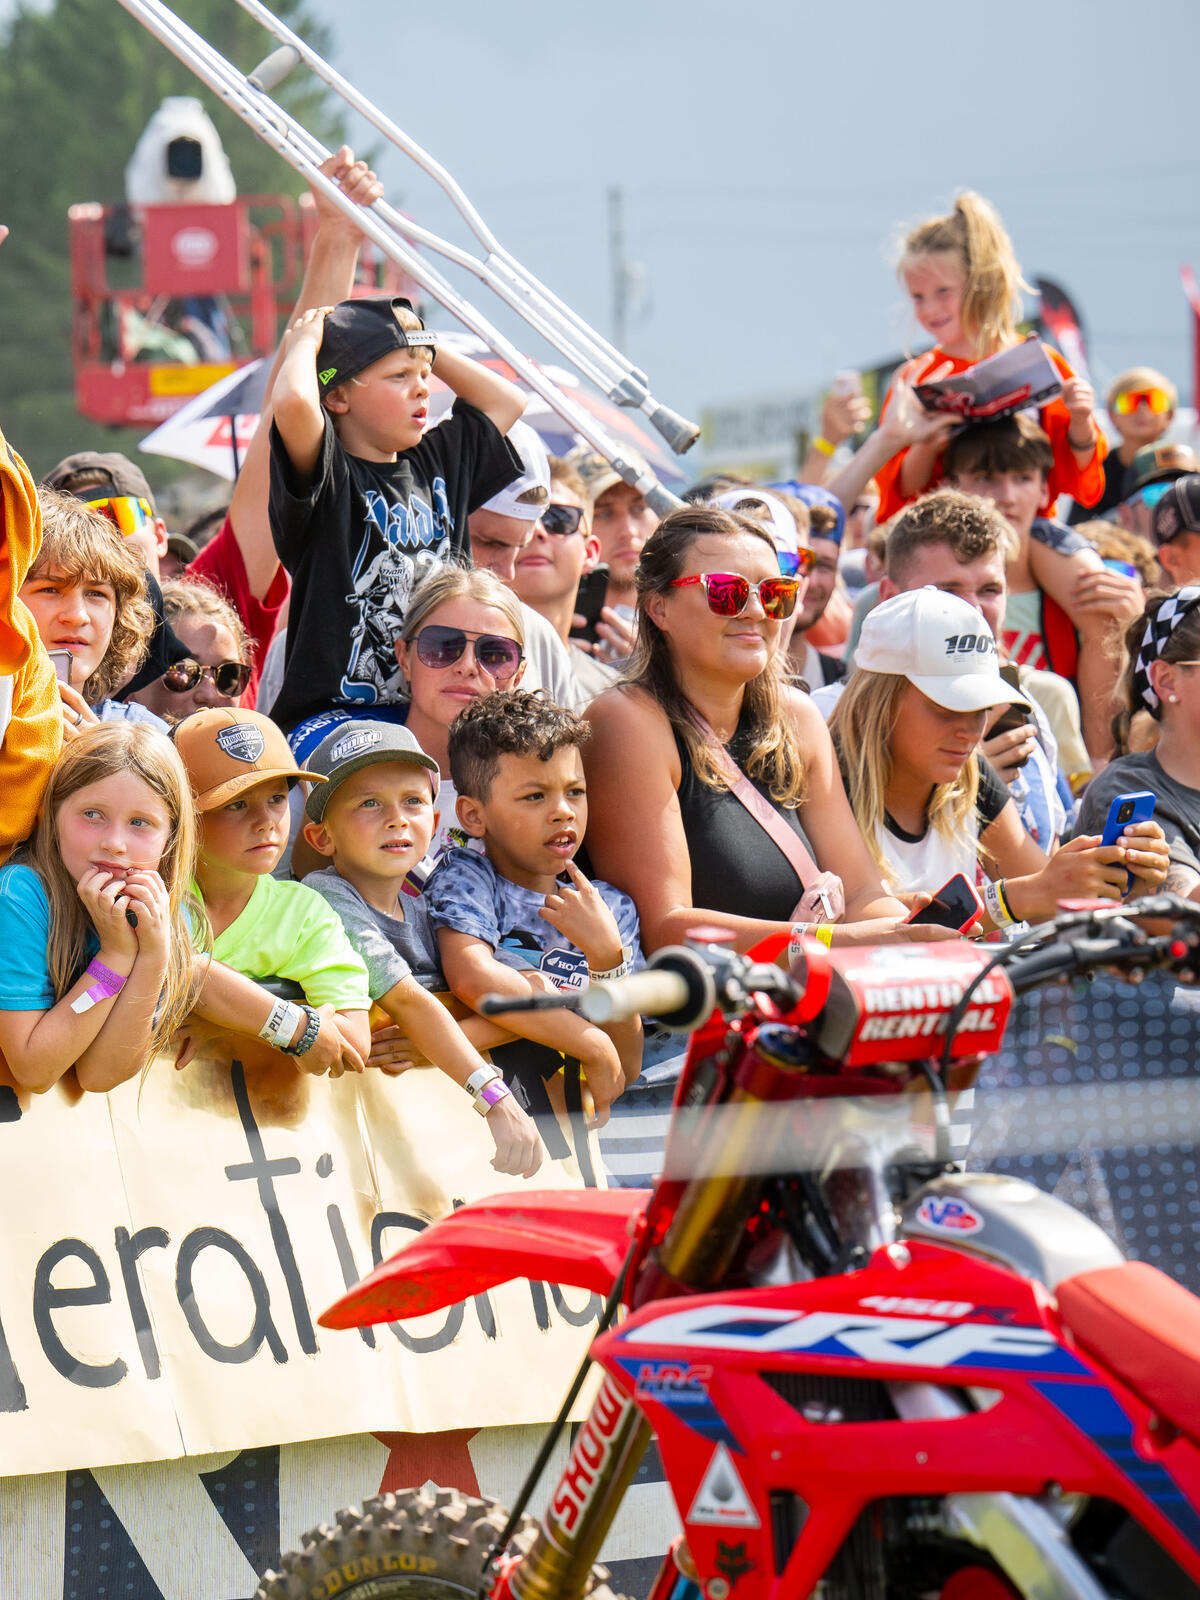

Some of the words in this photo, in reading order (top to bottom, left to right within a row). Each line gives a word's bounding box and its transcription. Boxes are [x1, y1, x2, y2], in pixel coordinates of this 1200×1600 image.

[624, 1304, 1058, 1367] CRF
[637, 1364, 713, 1393] HRC
[551, 1373, 633, 1540] SHOW
[324, 1553, 438, 1597] DUNLOP
